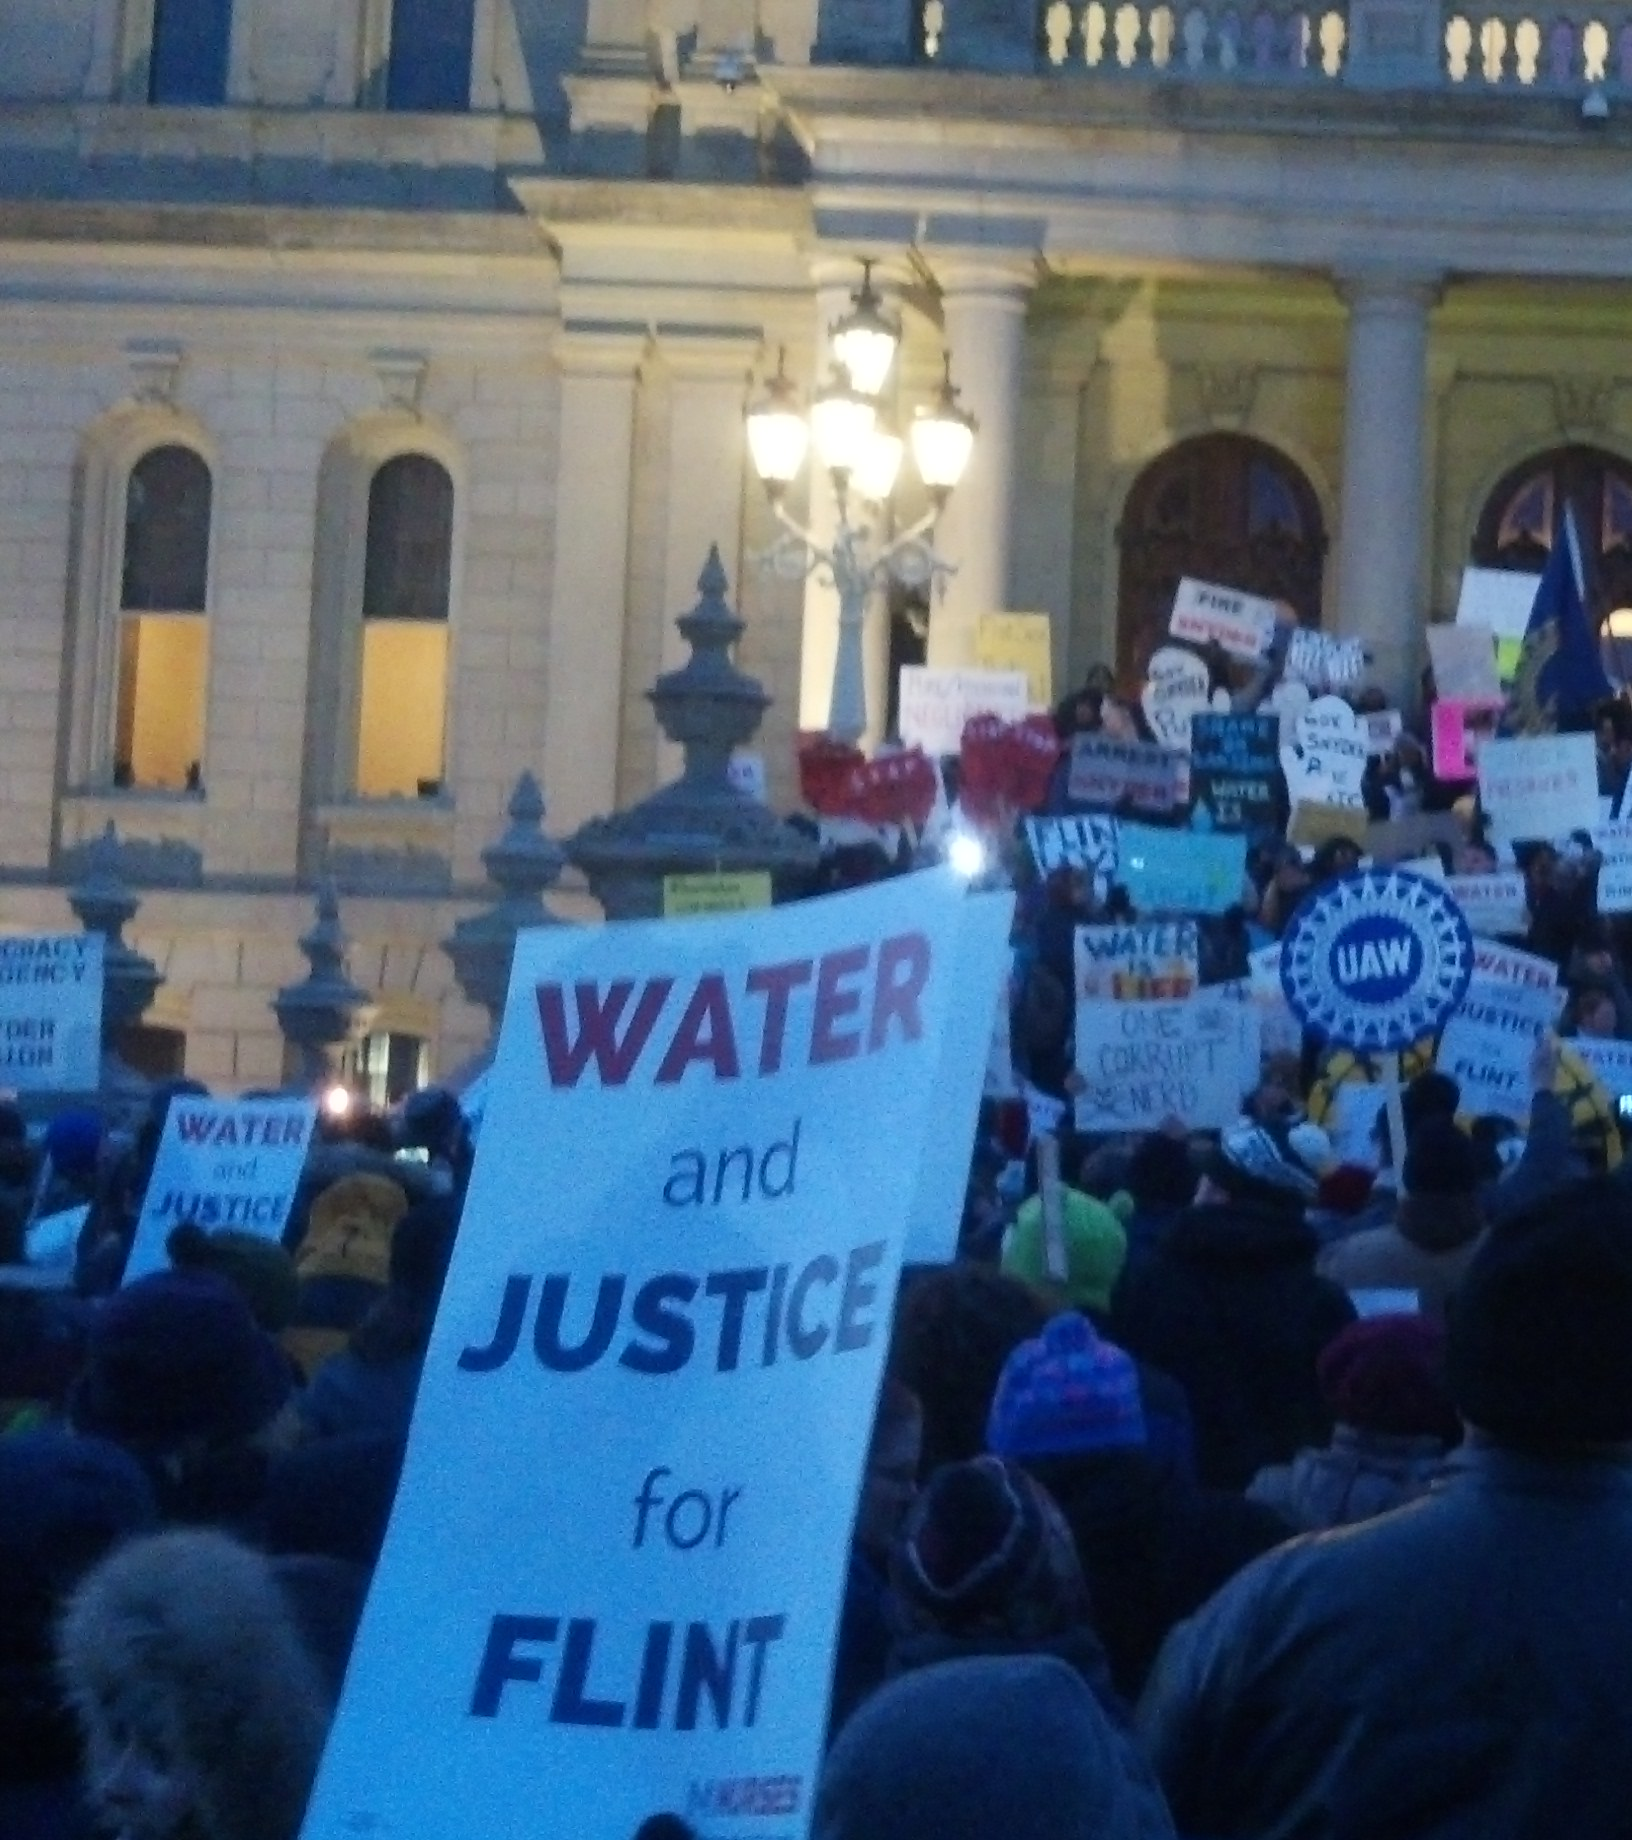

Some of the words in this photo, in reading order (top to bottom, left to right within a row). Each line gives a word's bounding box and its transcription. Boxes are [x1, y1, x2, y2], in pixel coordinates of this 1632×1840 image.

[1337, 938, 1412, 984] UAW
[1475, 953, 1551, 989] WATER
[535, 932, 932, 1088] WATER
[1457, 1001, 1544, 1037] JUSTICE
[1454, 1057, 1520, 1090] FLINT
[176, 1112, 306, 1146] WATER
[662, 1120, 800, 1206] and
[151, 1191, 287, 1223] JUSTICE
[457, 1241, 888, 1375] JUSTICE
[631, 1466, 745, 1549] for
[468, 1614, 785, 1731] FLINT
